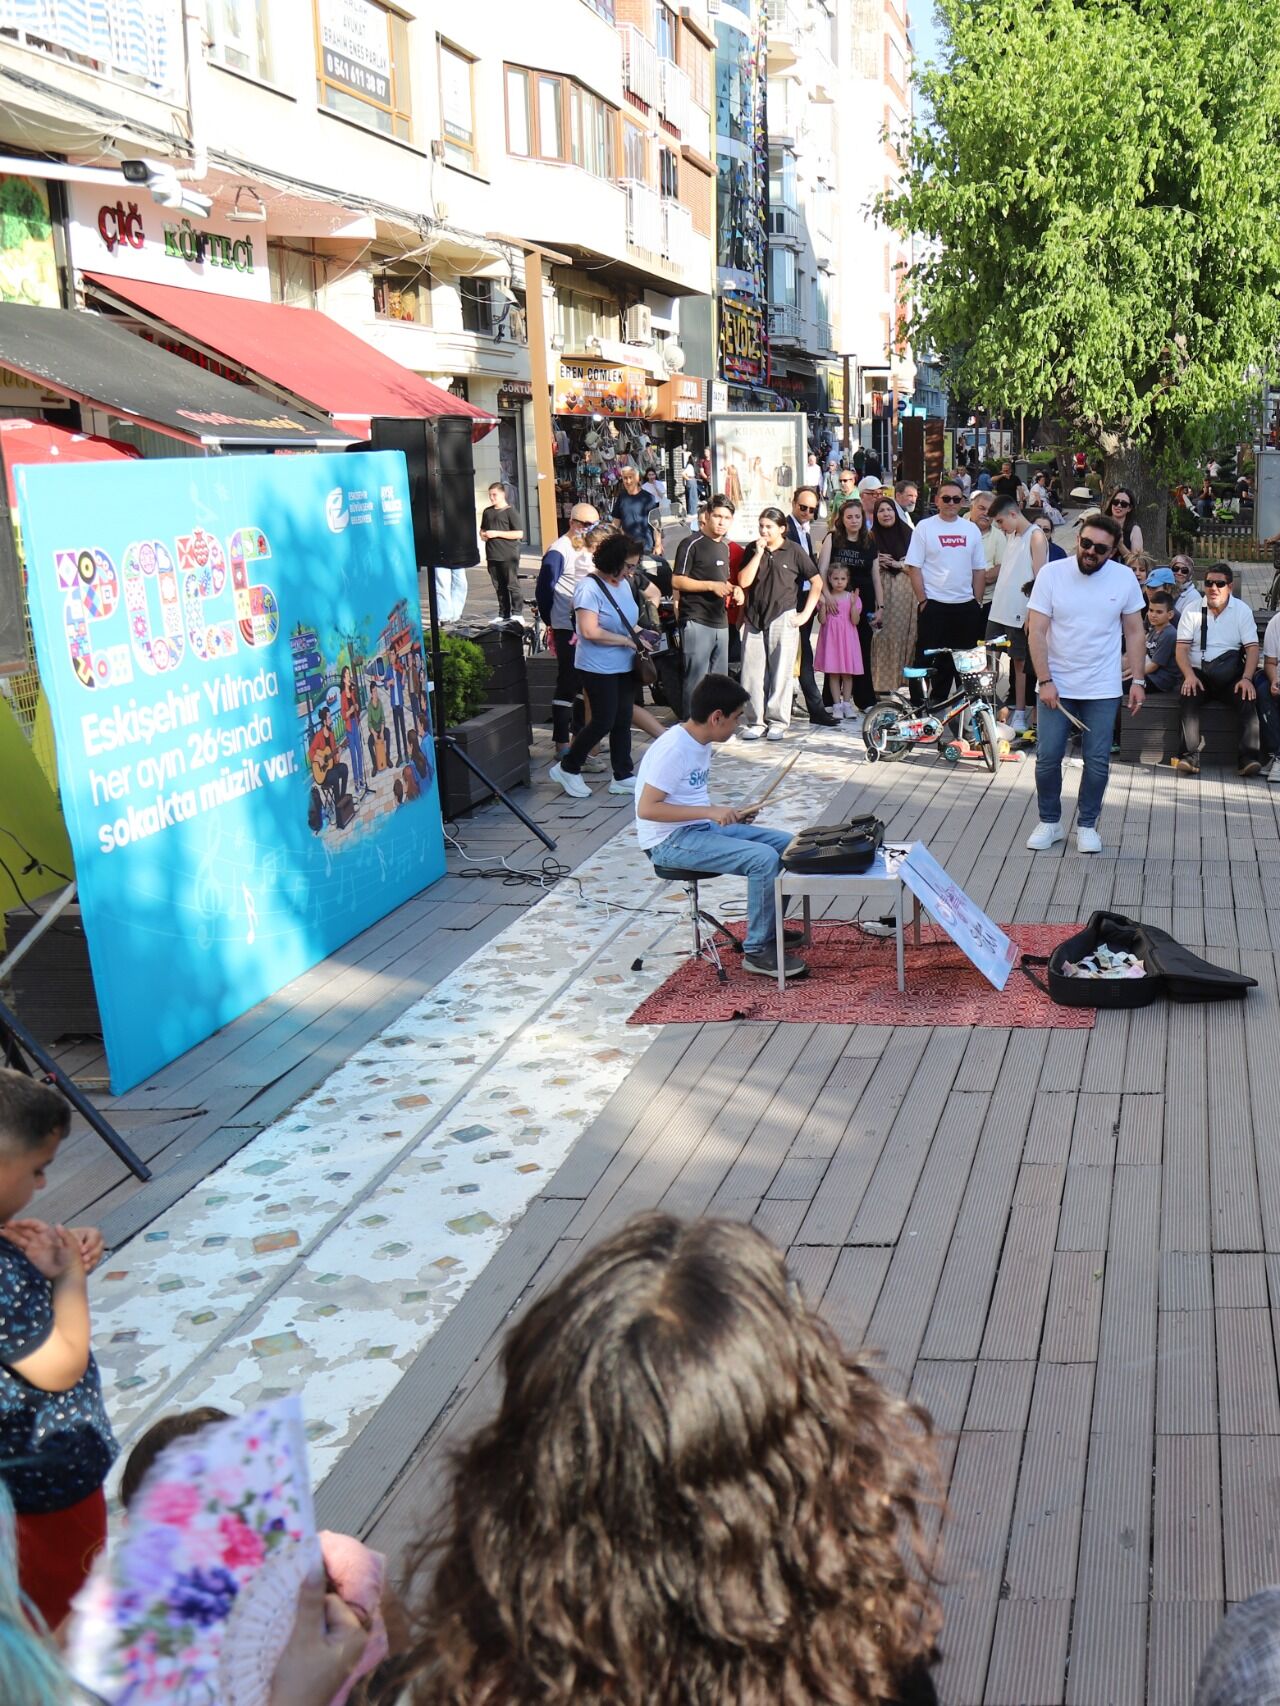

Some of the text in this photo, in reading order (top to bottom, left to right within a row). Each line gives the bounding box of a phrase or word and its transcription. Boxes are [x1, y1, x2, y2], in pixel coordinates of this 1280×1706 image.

[98, 200, 146, 253] ÇİĞ
[161, 218, 255, 274] KÖFTECİ
[560, 366, 584, 379] EREN
[80, 667, 279, 758] Eskişehir Yılı'nda
[89, 713, 273, 807] her ayın 26'sında
[98, 749, 299, 854] sokakta müzik var.
